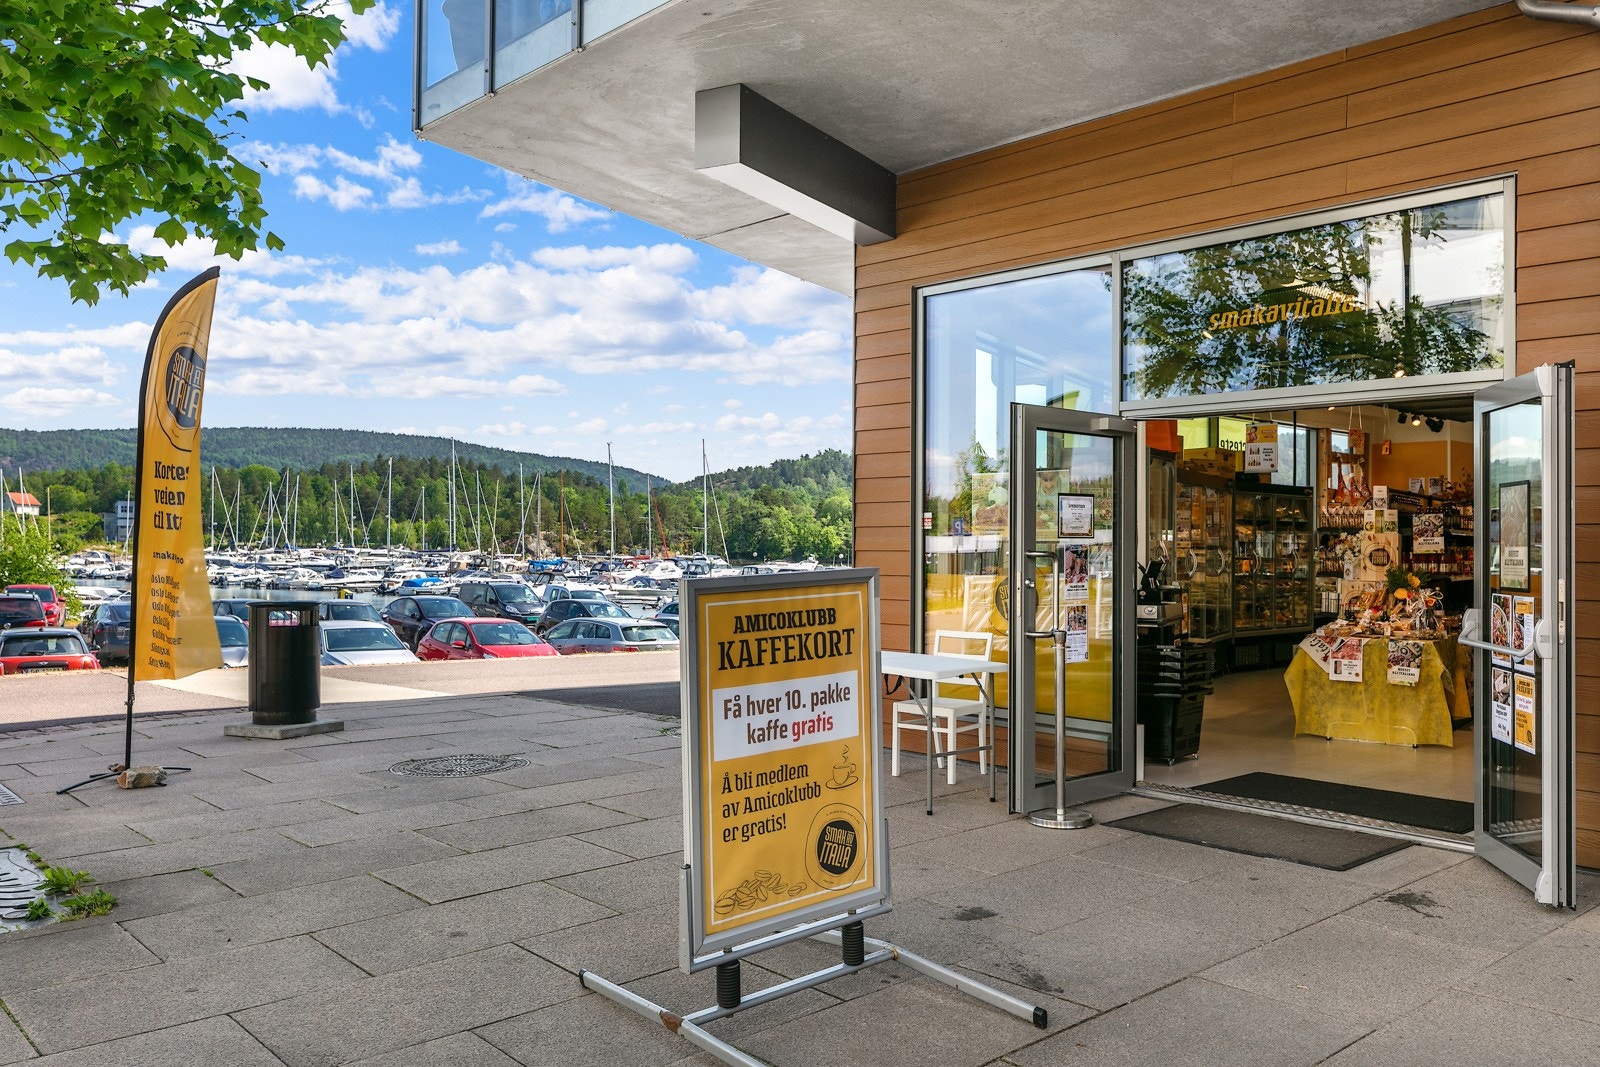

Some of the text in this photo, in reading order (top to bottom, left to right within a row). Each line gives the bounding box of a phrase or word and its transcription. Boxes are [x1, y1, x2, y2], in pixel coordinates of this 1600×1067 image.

[167, 373, 201, 420] ITALIA
[154, 488, 185, 506] veien
[154, 512, 164, 530] til
[733, 608, 836, 634] AMICOKLUBB
[718, 628, 855, 670] KAFFEKORT
[724, 683, 850, 720] Få hver 10. pakke
[747, 711, 834, 744] kaffe gratis
[721, 764, 808, 794] Å bli medlem
[722, 781, 821, 818] av Amicoklubb
[723, 813, 786, 842] er gratis!
[824, 825, 847, 845] SMAK
[820, 841, 852, 868] ITALIA
